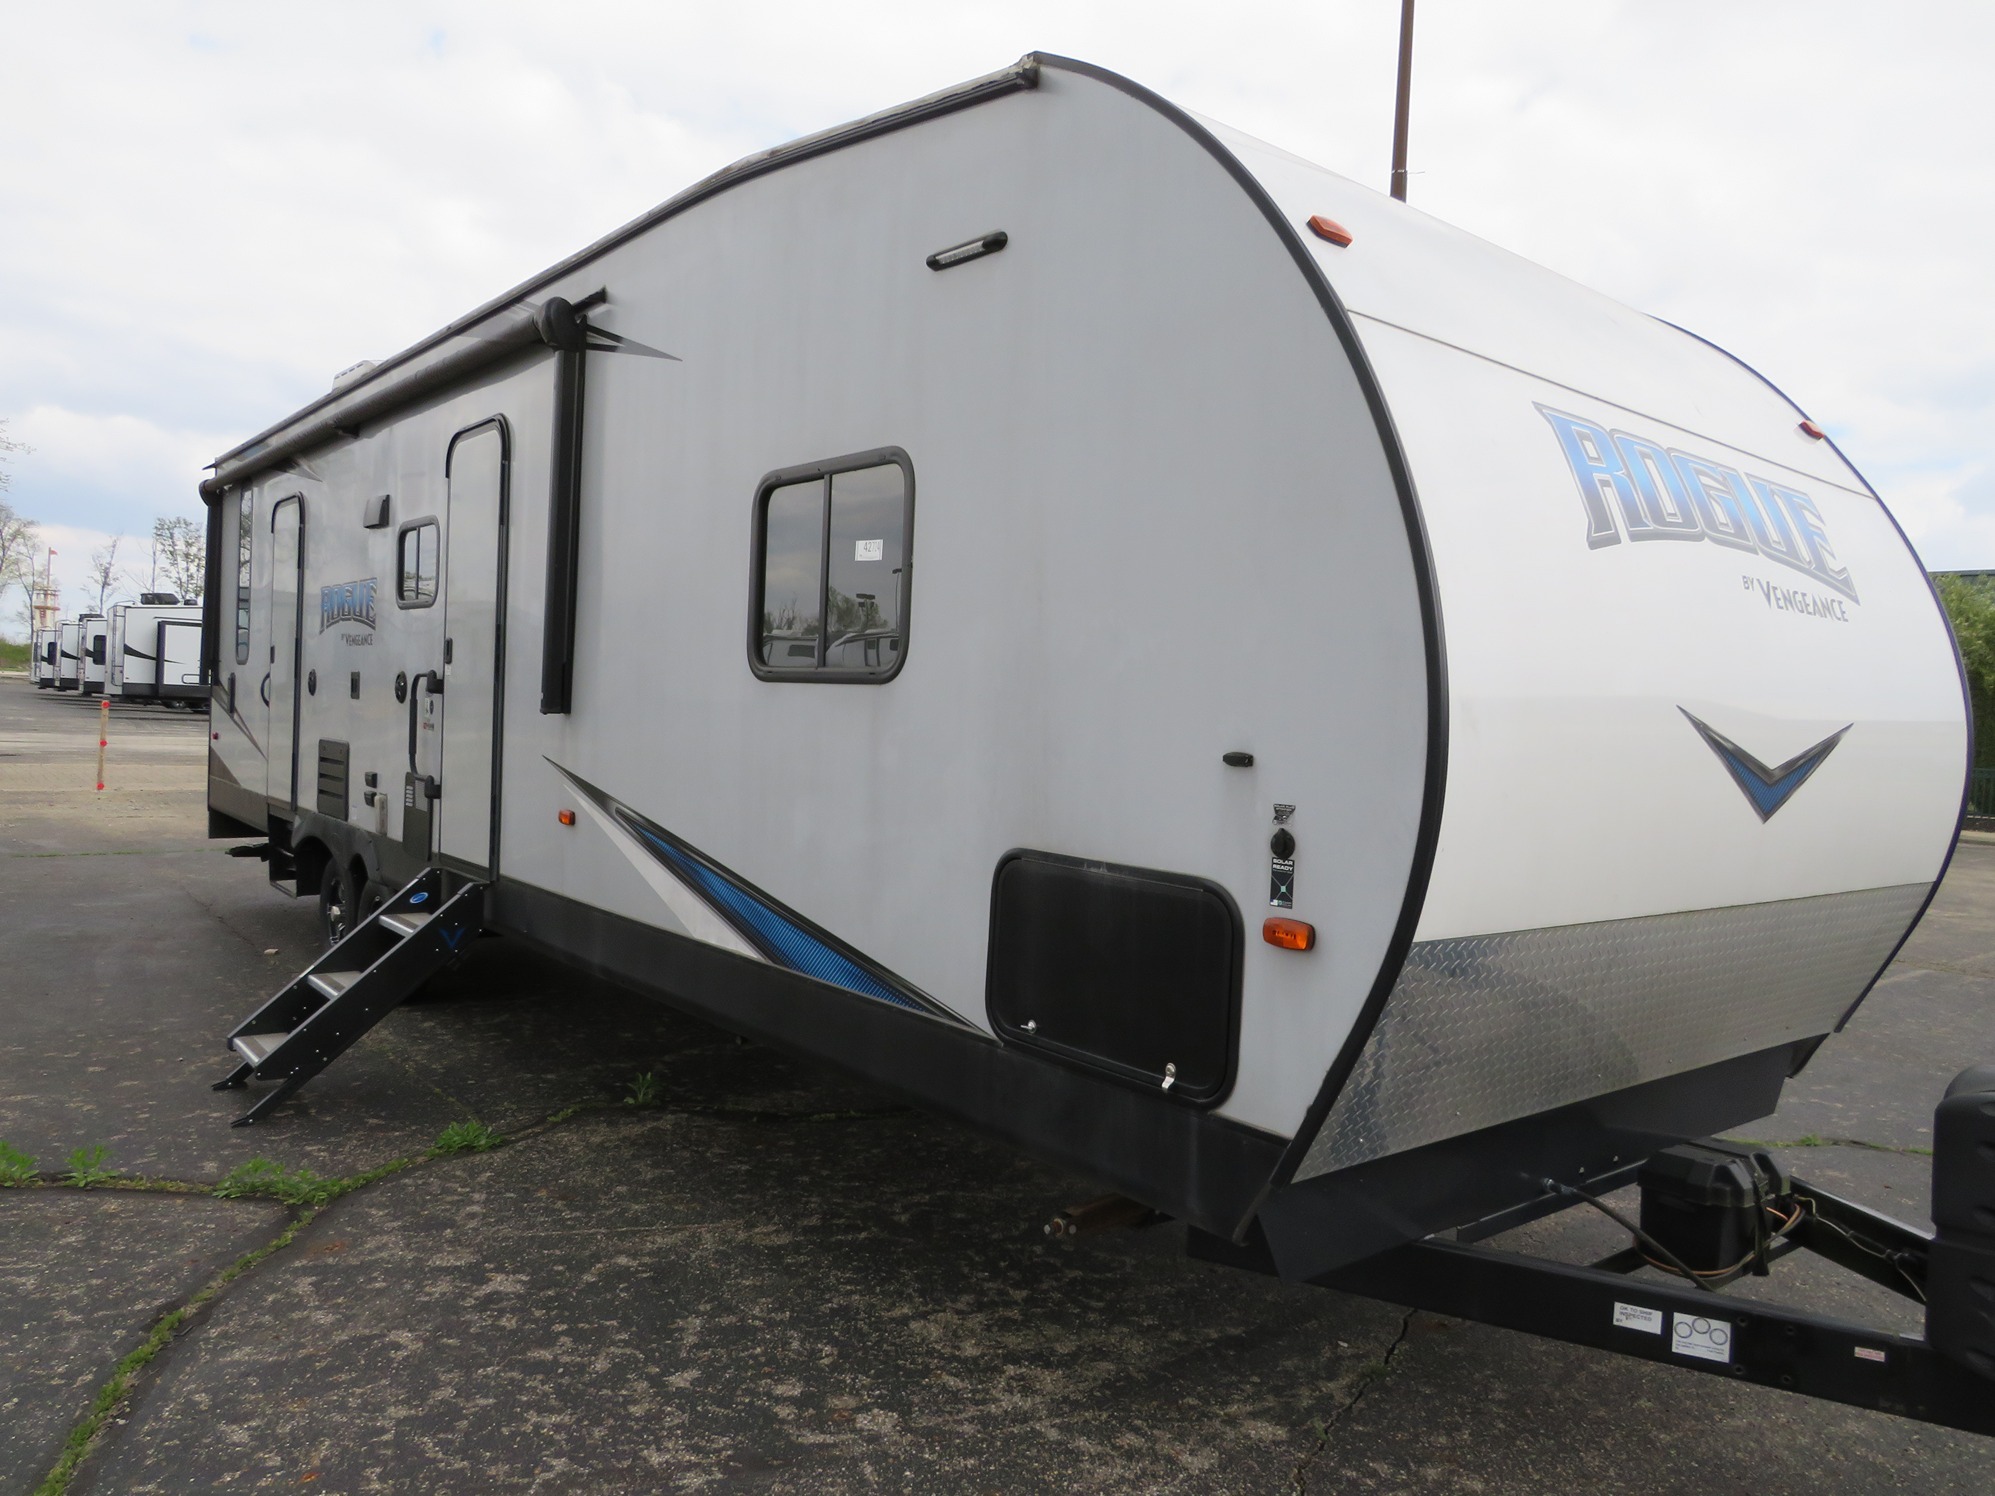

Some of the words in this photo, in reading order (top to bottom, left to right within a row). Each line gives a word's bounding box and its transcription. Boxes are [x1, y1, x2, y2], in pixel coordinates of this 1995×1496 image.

[1531, 401, 1860, 606] ROGUE
[1741, 575, 1755, 591] BY
[1756, 578, 1849, 622] VENGEANCE
[319, 577, 377, 635] ROGUE
[346, 633, 374, 647] VENGEANCE
[1272, 858, 1293, 866] SOLAR
[1272, 864, 1294, 872] READY
[1619, 1311, 1653, 1322] INSPECTED
